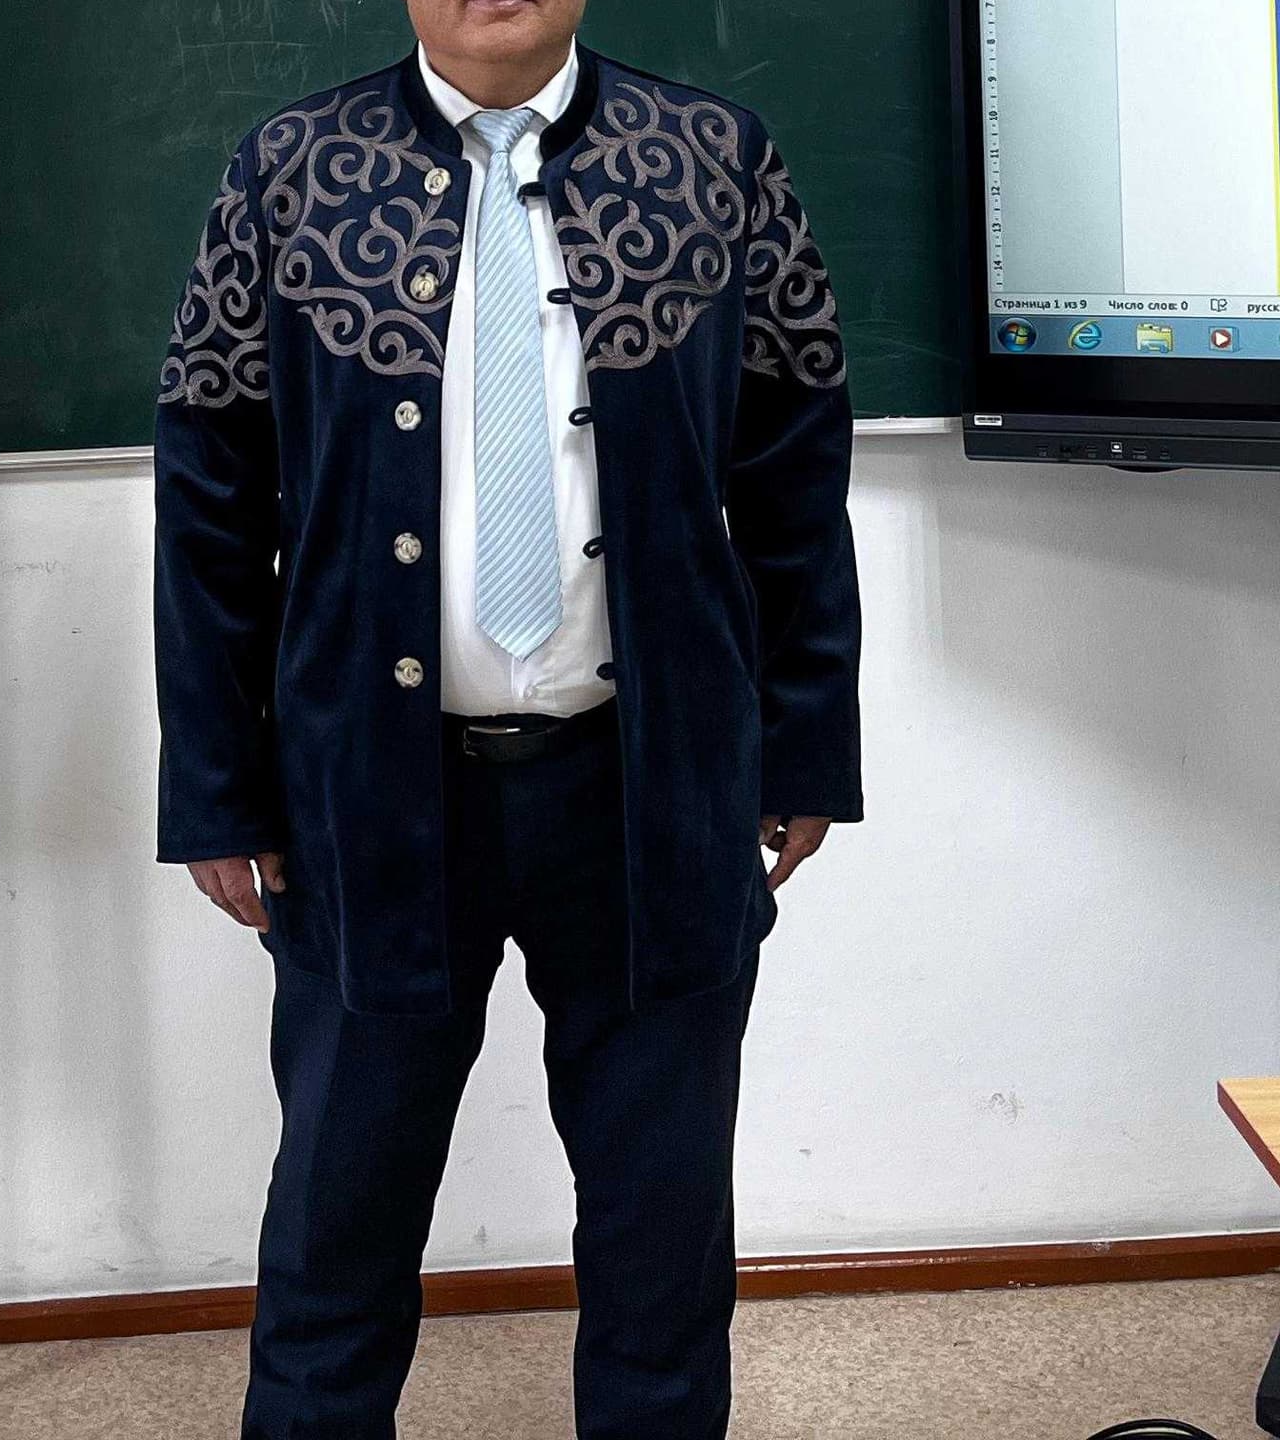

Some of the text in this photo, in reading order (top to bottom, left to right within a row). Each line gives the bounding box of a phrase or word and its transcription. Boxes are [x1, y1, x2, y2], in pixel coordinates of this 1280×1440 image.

[994, 298, 1050, 310] Страница
[1064, 300, 1078, 309] из
[1080, 299, 1087, 310] 9
[1108, 300, 1188, 312] Число слов: 0
